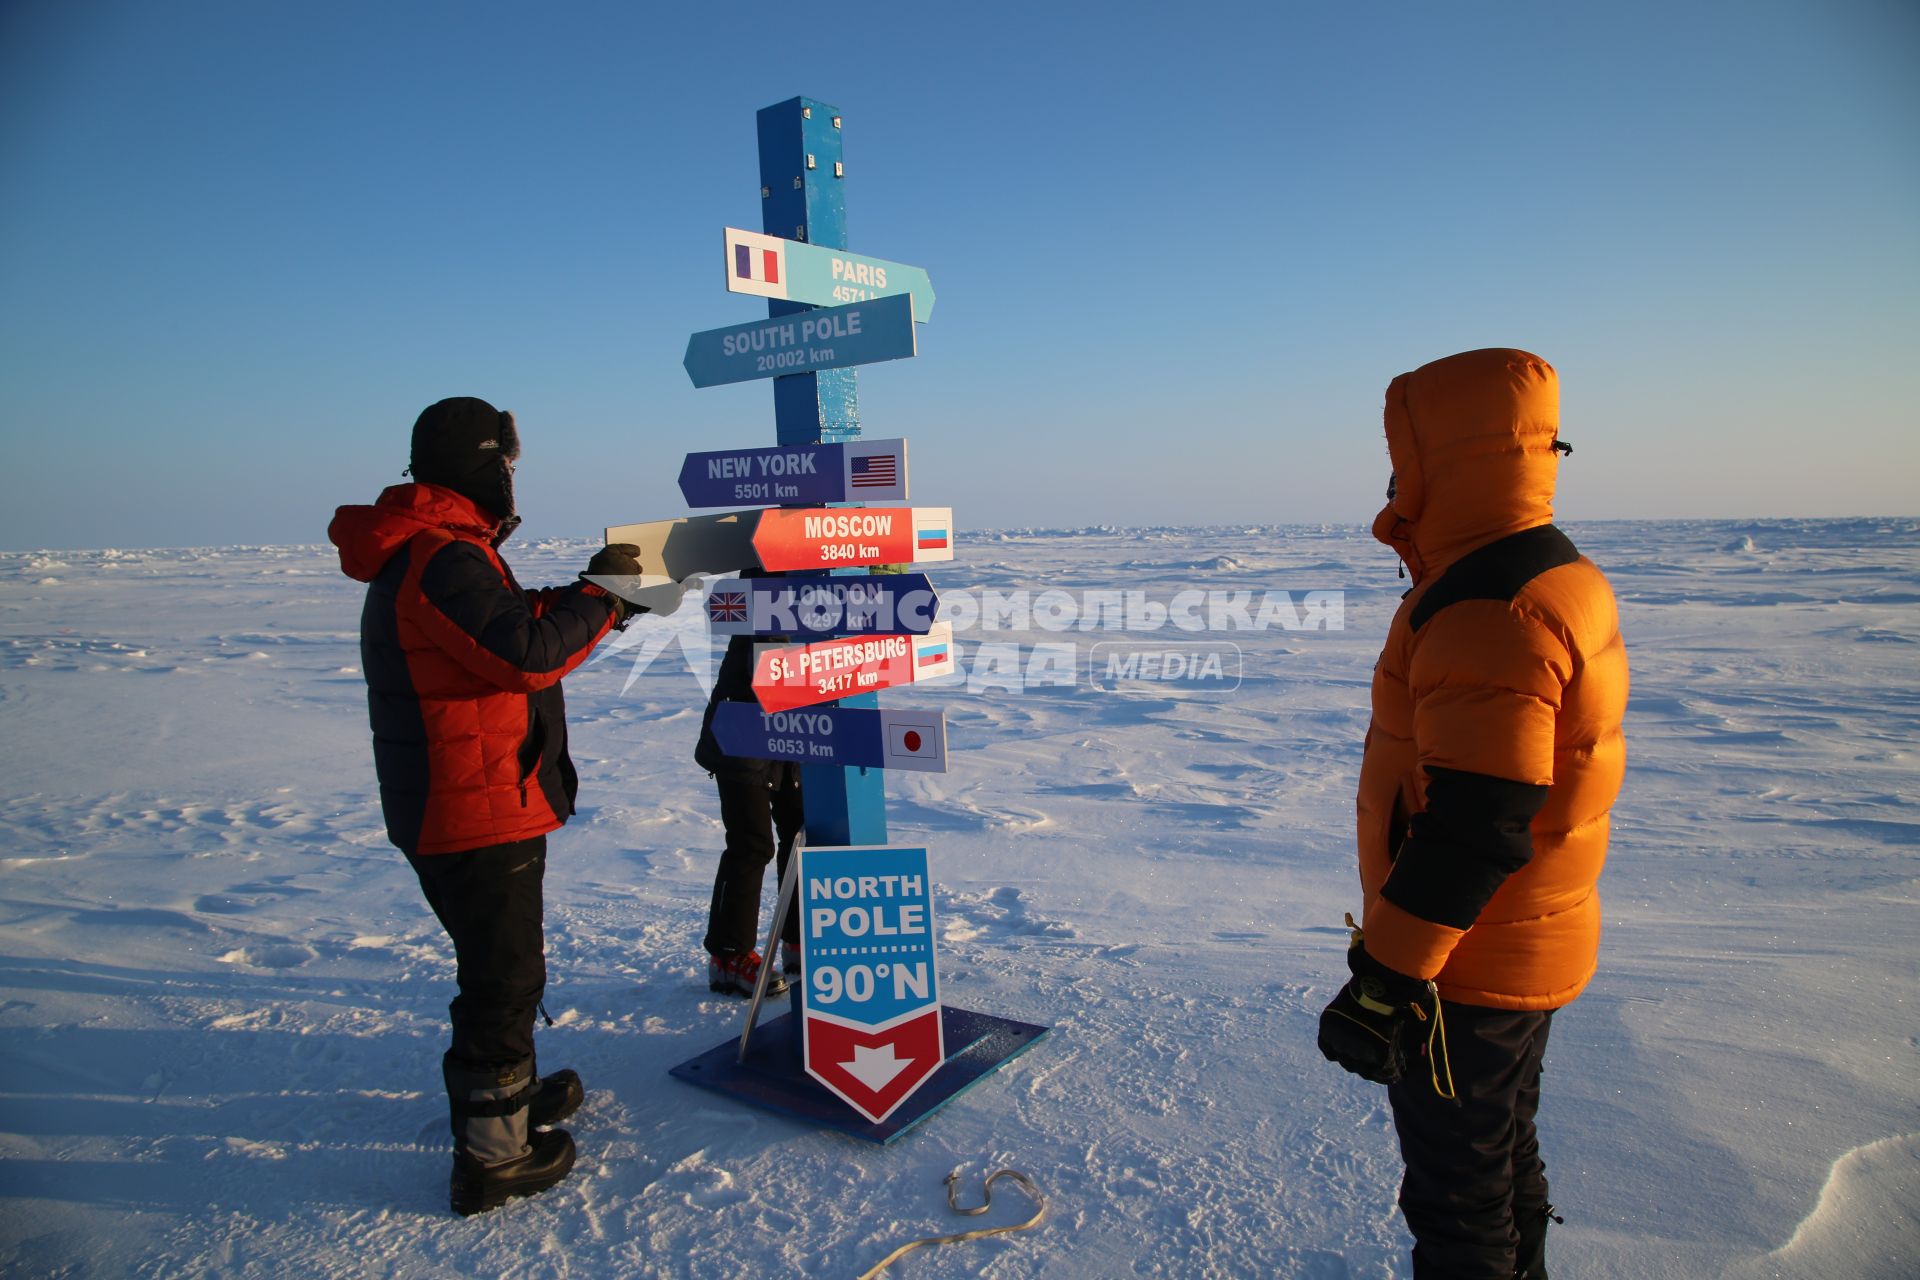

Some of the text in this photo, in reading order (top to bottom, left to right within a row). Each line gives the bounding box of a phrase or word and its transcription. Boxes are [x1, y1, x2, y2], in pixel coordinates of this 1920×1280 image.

[831, 258, 887, 289] PARIS
[832, 285, 865, 304] 4571
[722, 311, 862, 357] SOUTH POLE
[809, 345, 835, 363] km
[708, 452, 817, 480] NEW YORK
[734, 482, 799, 499] 5501 km
[804, 515, 892, 539] MOSCOW
[820, 544, 880, 561] 3840 km
[788, 583, 884, 607] LONDON
[803, 611, 873, 629] 4297 km
[769, 636, 907, 681] St. PETERSBURG
[818, 671, 878, 695] 3417 km
[760, 711, 833, 736] TOKYO
[767, 738, 834, 757] 6053 km
[810, 874, 922, 900] NORTH
[811, 904, 925, 938] POLE
[812, 962, 929, 1004] 90°N
